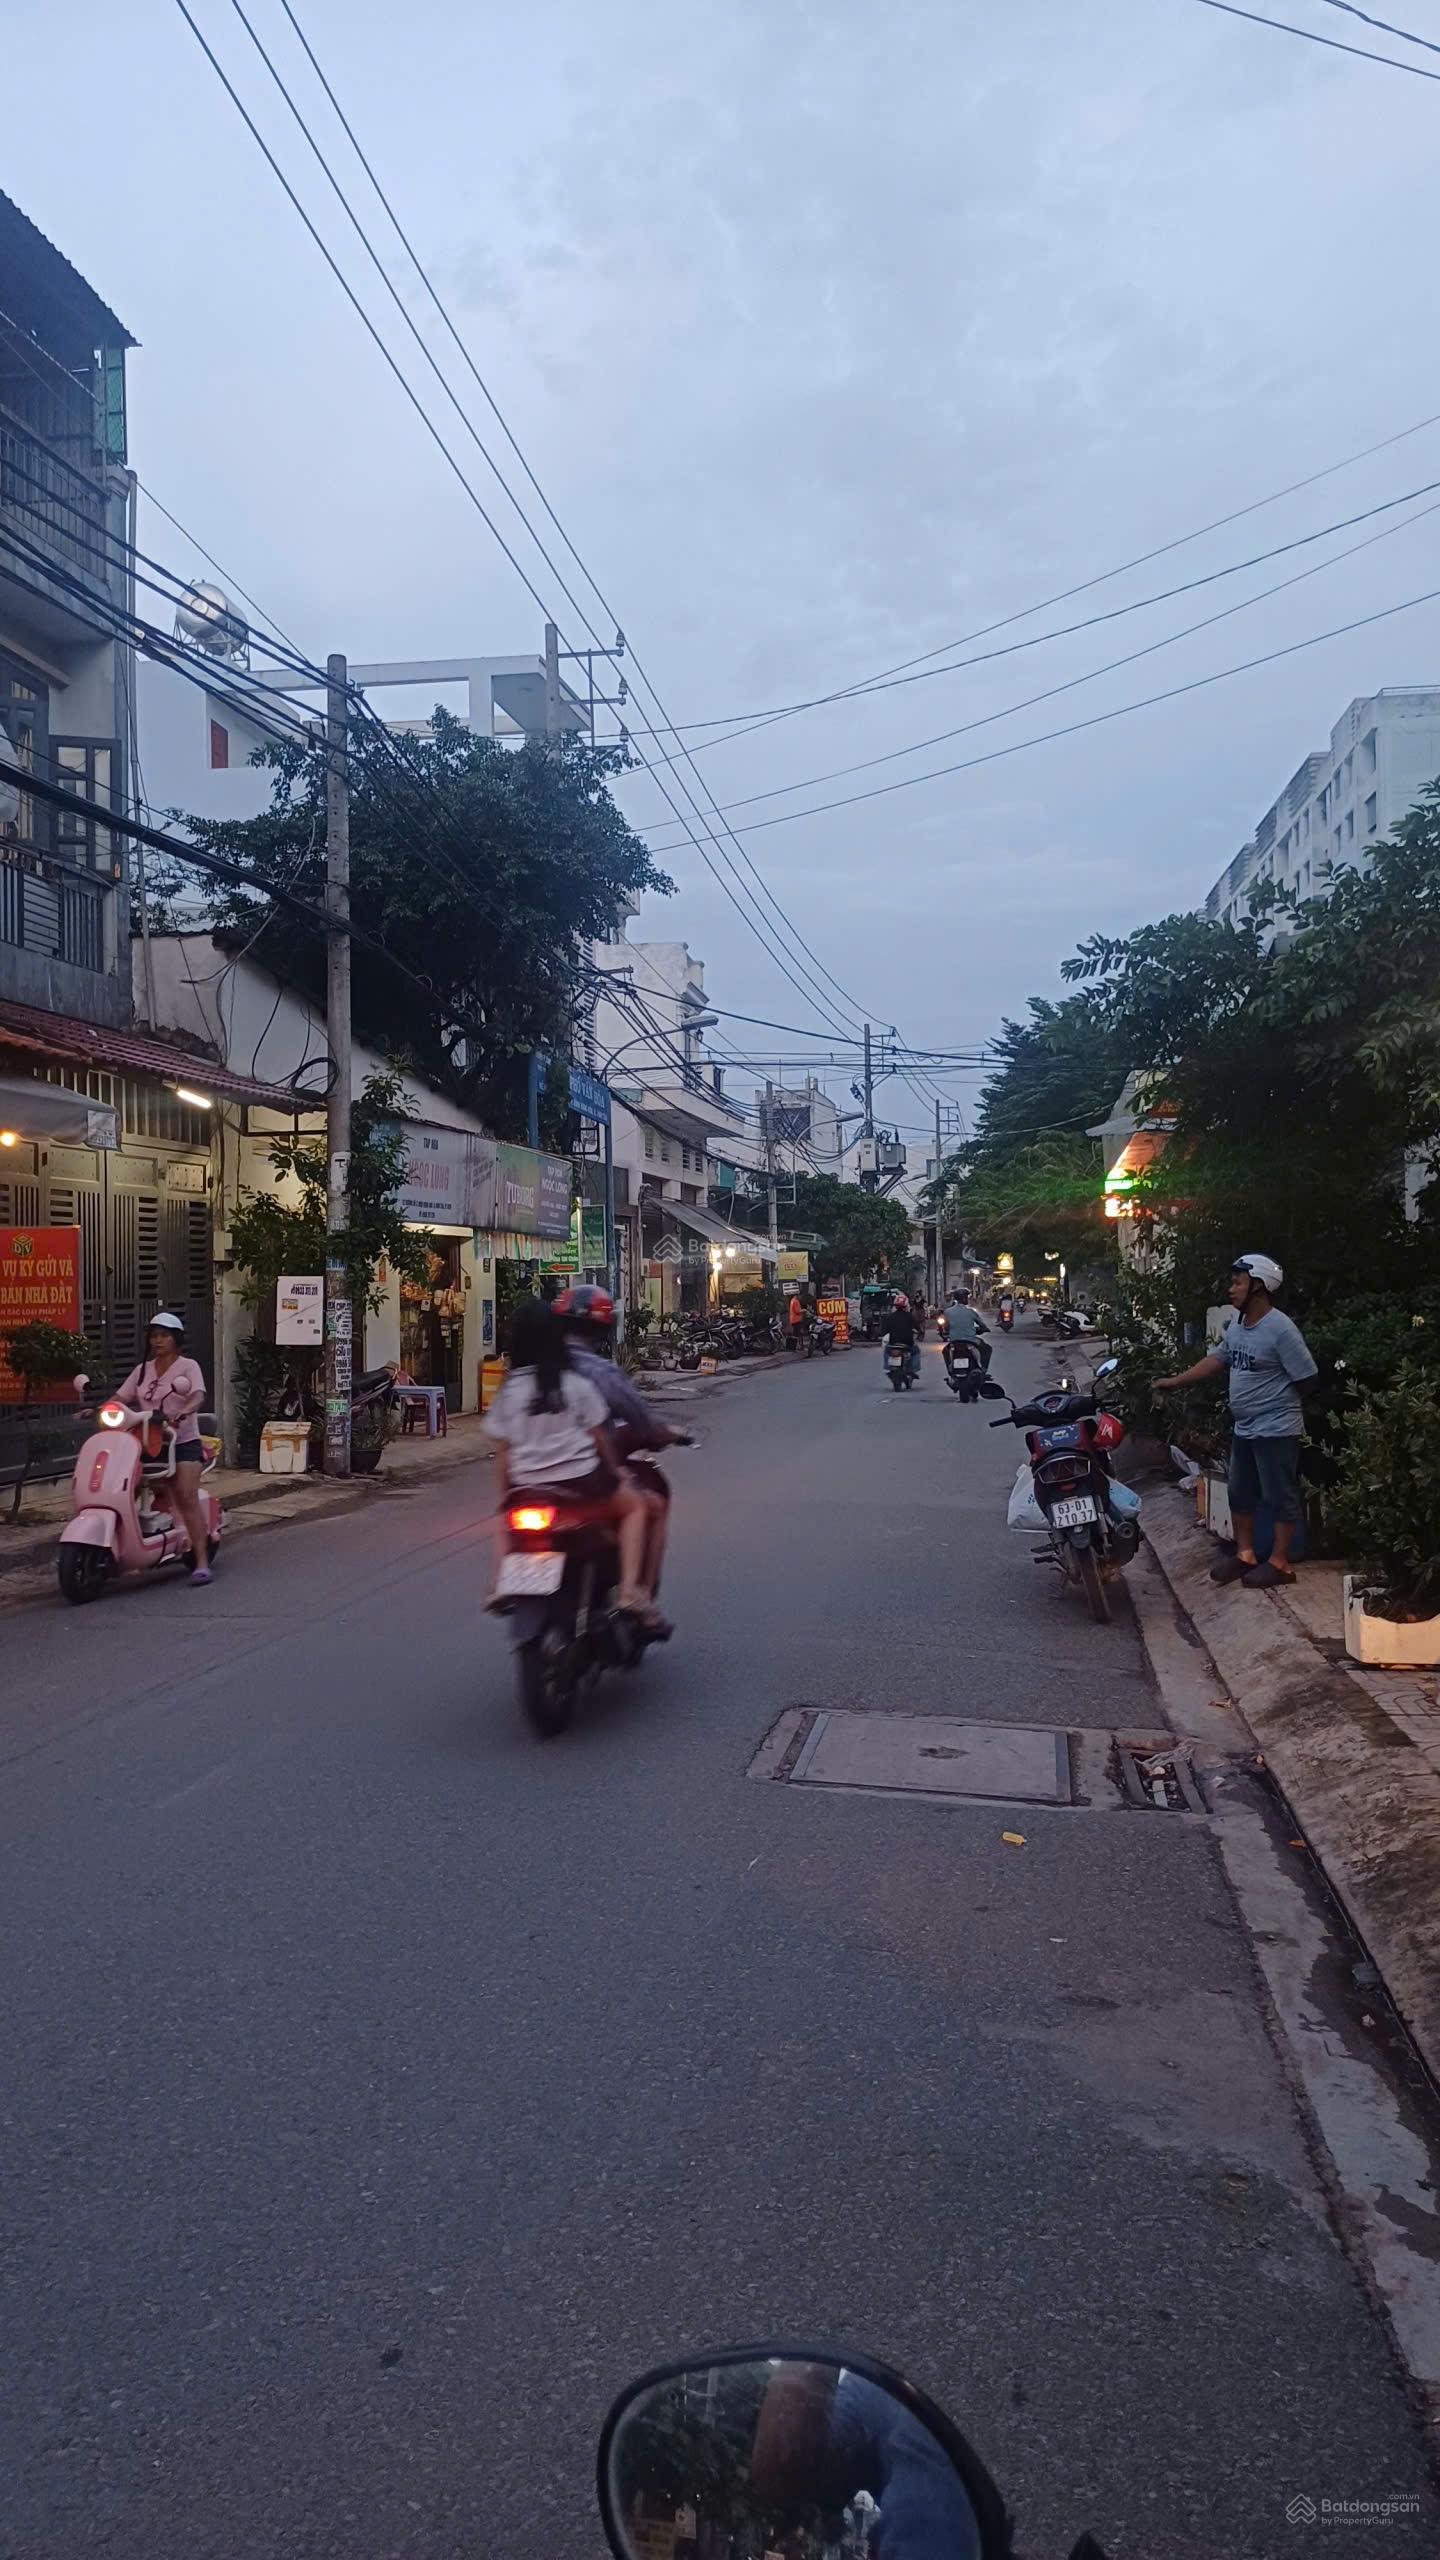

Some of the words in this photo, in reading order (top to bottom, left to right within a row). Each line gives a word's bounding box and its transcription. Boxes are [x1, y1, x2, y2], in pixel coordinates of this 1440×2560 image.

[555, 1181, 568, 1195] LONG
[2, 1260, 17, 1281] VỤ
[59, 1254, 74, 1277] VÀ
[25, 1282, 48, 1304] NHÀ
[819, 1299, 846, 1314] CƠM
[1058, 1499, 1087, 1515] 63-D1
